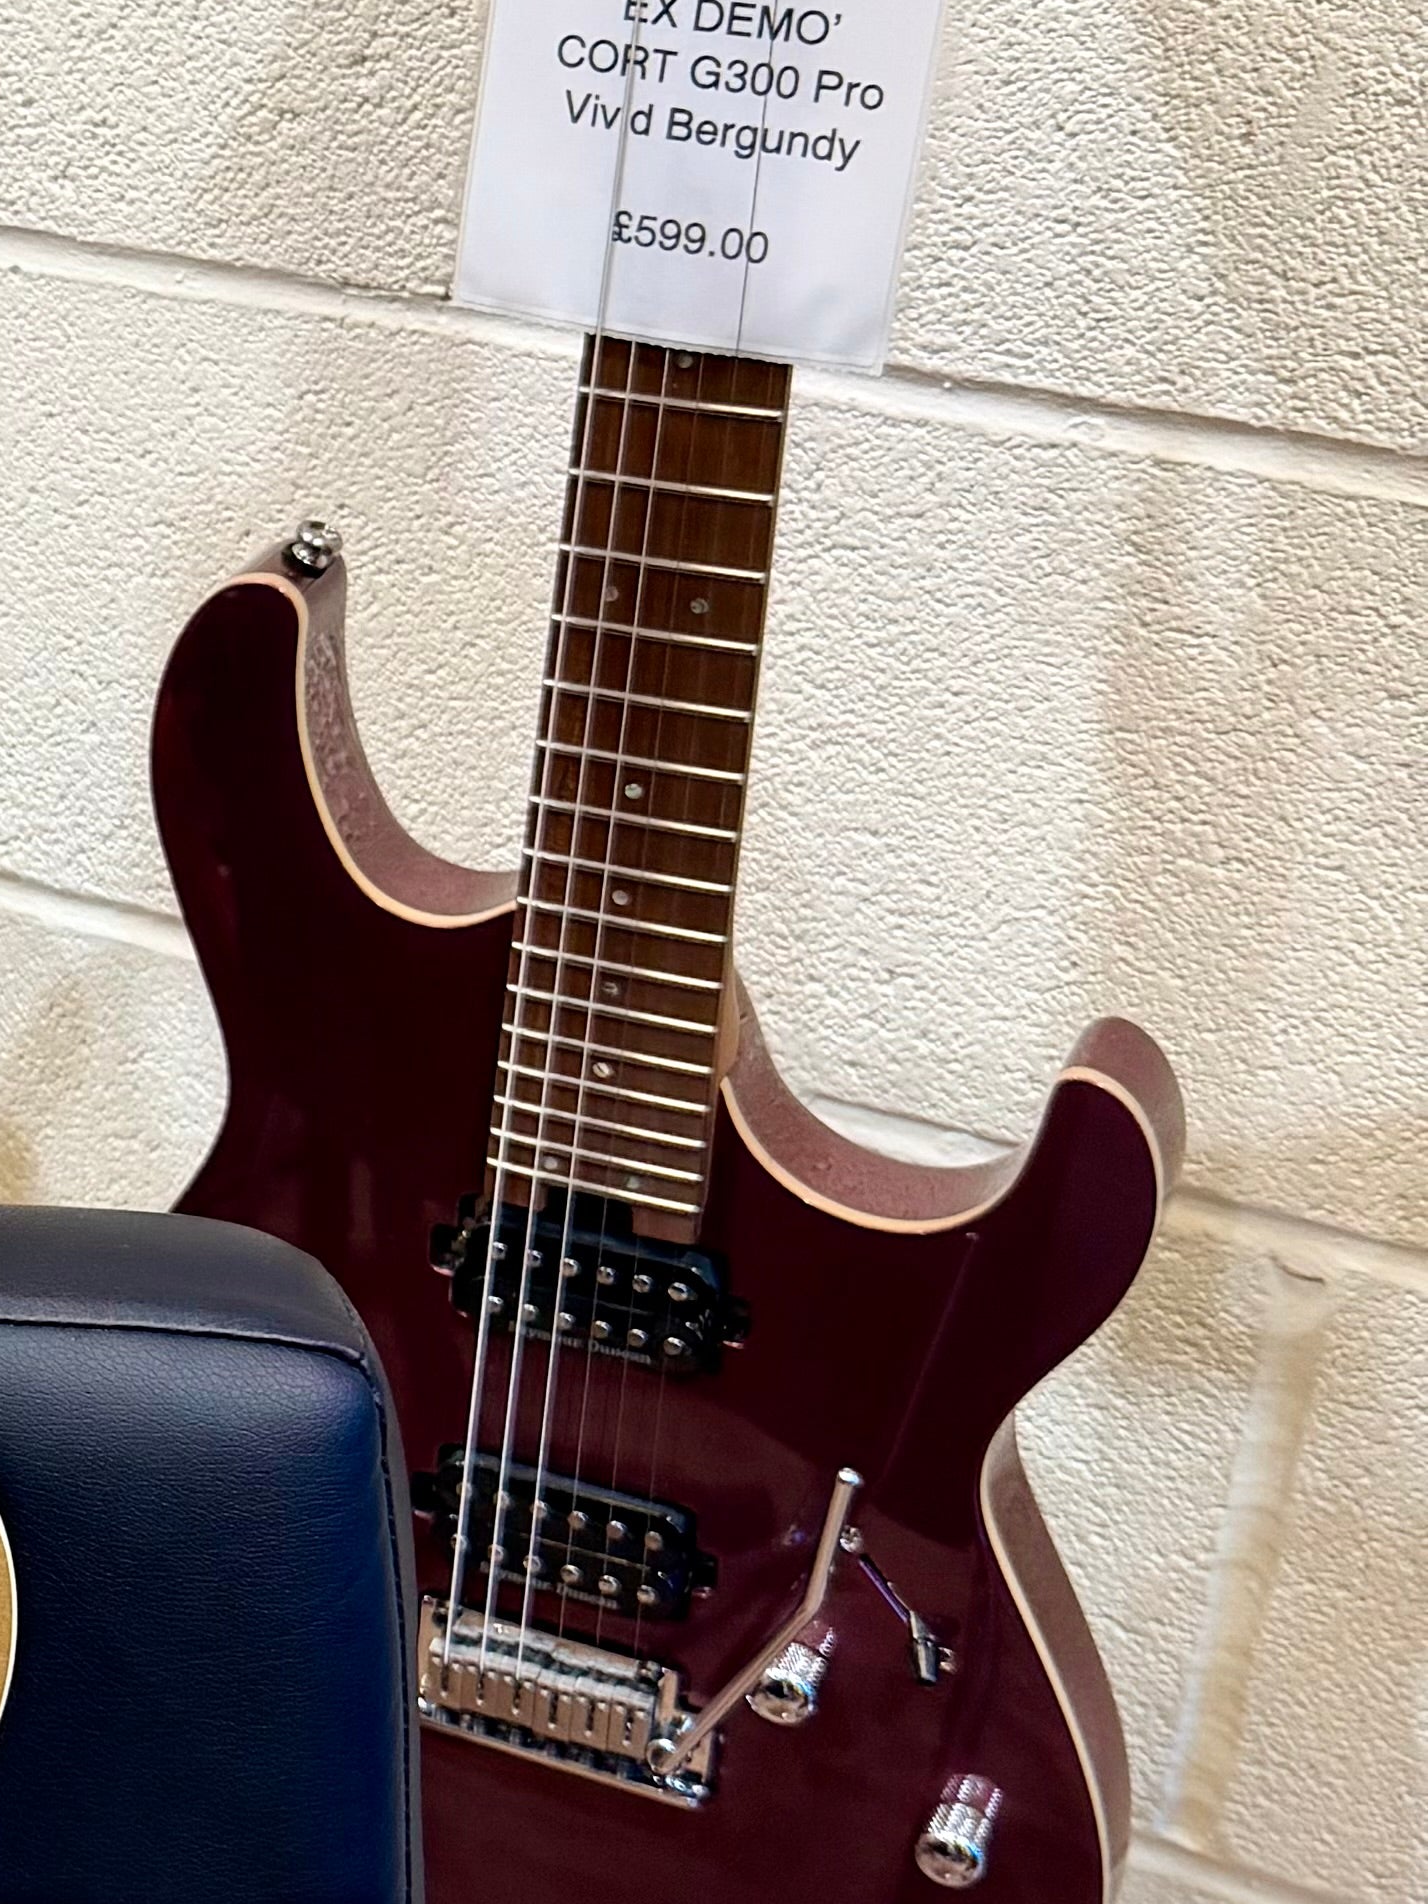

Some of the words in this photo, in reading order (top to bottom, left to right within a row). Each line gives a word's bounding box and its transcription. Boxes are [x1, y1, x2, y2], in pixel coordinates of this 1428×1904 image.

[558, 35, 678, 84] CORT
[690, 55, 798, 100] G300
[815, 70, 884, 111] Pro
[565, 91, 653, 137] Vivd
[667, 108, 860, 170] Bergundy
[613, 211, 769, 264] £599.00
